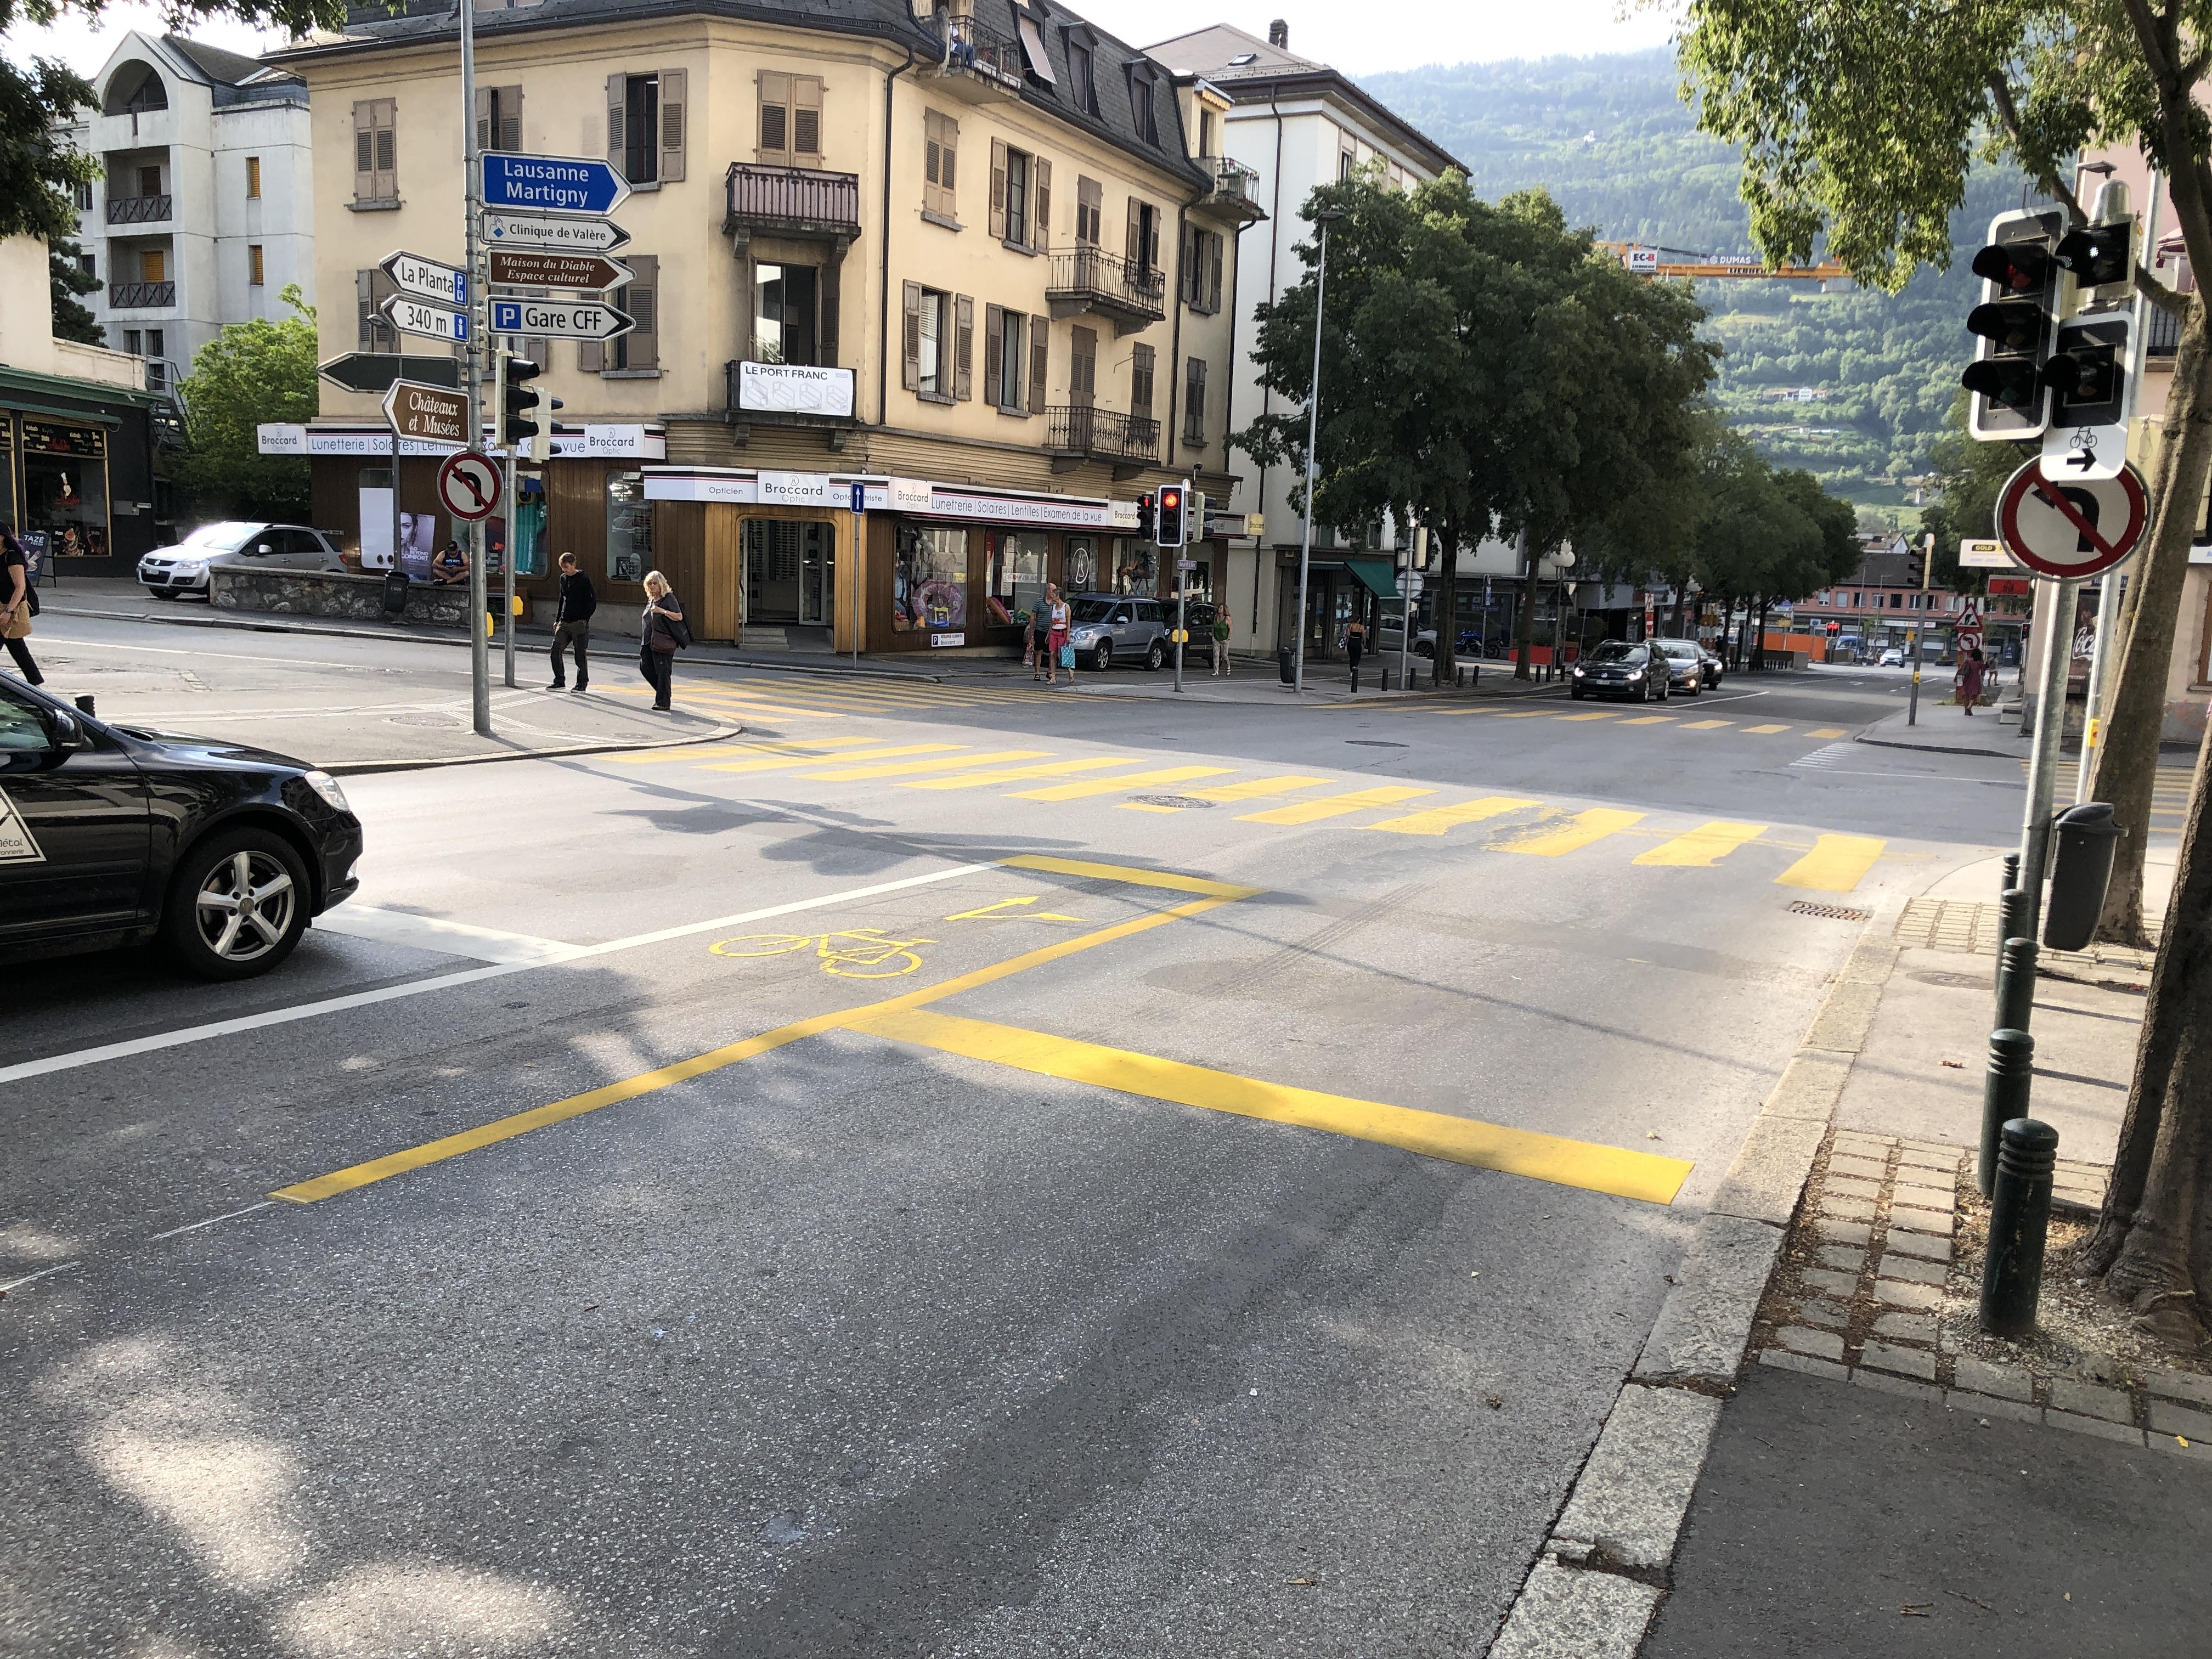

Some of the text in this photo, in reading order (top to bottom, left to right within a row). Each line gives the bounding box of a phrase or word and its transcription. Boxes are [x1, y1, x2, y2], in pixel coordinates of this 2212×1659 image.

[504, 159, 589, 182] Lausanne
[506, 181, 588, 207] Martigny
[510, 224, 606, 241] Clinique de Valère
[500, 256, 595, 272] Maison du Diable
[1633, 253, 1655, 262] EC-B
[1719, 256, 1751, 264] DUMAS
[402, 262, 454, 294] La Planta
[507, 269, 590, 284] Espace culturel
[408, 306, 447, 334] 340 m
[503, 307, 515, 326] P
[526, 307, 602, 330] Gare CFF
[745, 366, 758, 375] LE
[760, 368, 789, 378] PORT
[792, 370, 828, 380] FRANC
[409, 391, 459, 416] Châteaux
[409, 414, 460, 437] et Musées
[262, 435, 297, 445] Broccard
[312, 438, 365, 450] Lunetterie
[373, 438, 414, 451] Solares
[563, 443, 585, 453] vue
[590, 436, 634, 447] Broccard
[602, 447, 621, 455] Optic
[709, 487, 743, 495] Opticien
[765, 483, 823, 496] Broccard
[898, 490, 928, 503] Broccard
[782, 494, 805, 503] Optic
[833, 493, 882, 502] Optotriste
[932, 496, 1102, 522] Lunetterie Solaires Lentilles Examen de la vue
[1115, 510, 1135, 520] Broccard
[24, 534, 44, 543] TAZÉ
